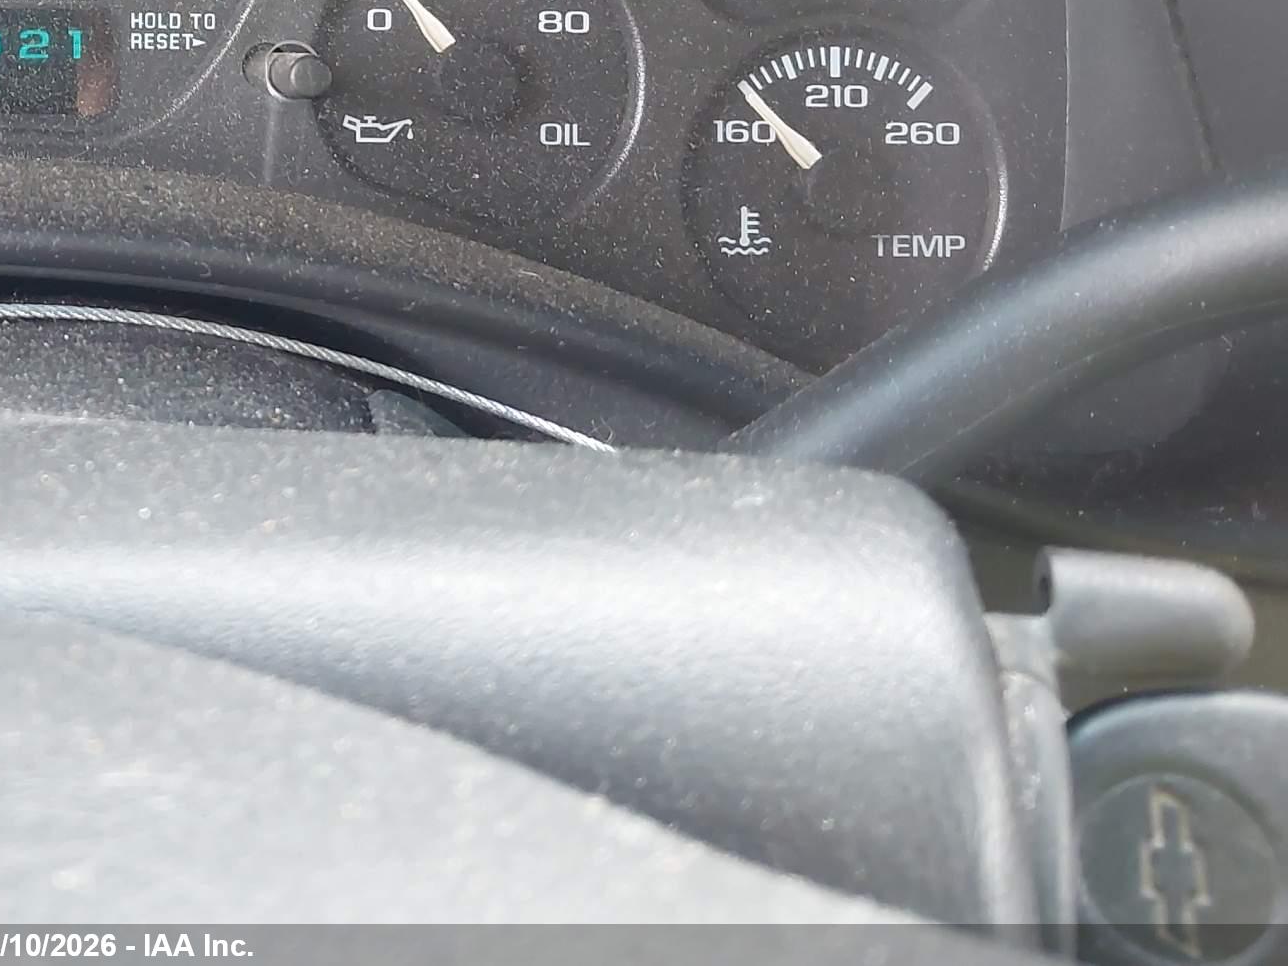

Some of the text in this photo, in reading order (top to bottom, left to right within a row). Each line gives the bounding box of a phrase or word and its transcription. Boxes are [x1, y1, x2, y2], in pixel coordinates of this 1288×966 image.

[130, 12, 216, 30] HOLD TO
[367, 8, 392, 31] 0
[538, 10, 590, 34] 80
[18, 29, 50, 60] 2
[67, 27, 83, 60] 1
[130, 32, 194, 50] RESET
[805, 84, 868, 108] 210
[540, 123, 591, 146] OIL
[712, 119, 777, 144] 160
[885, 121, 960, 145] 260
[870, 234, 966, 258] TEMP
